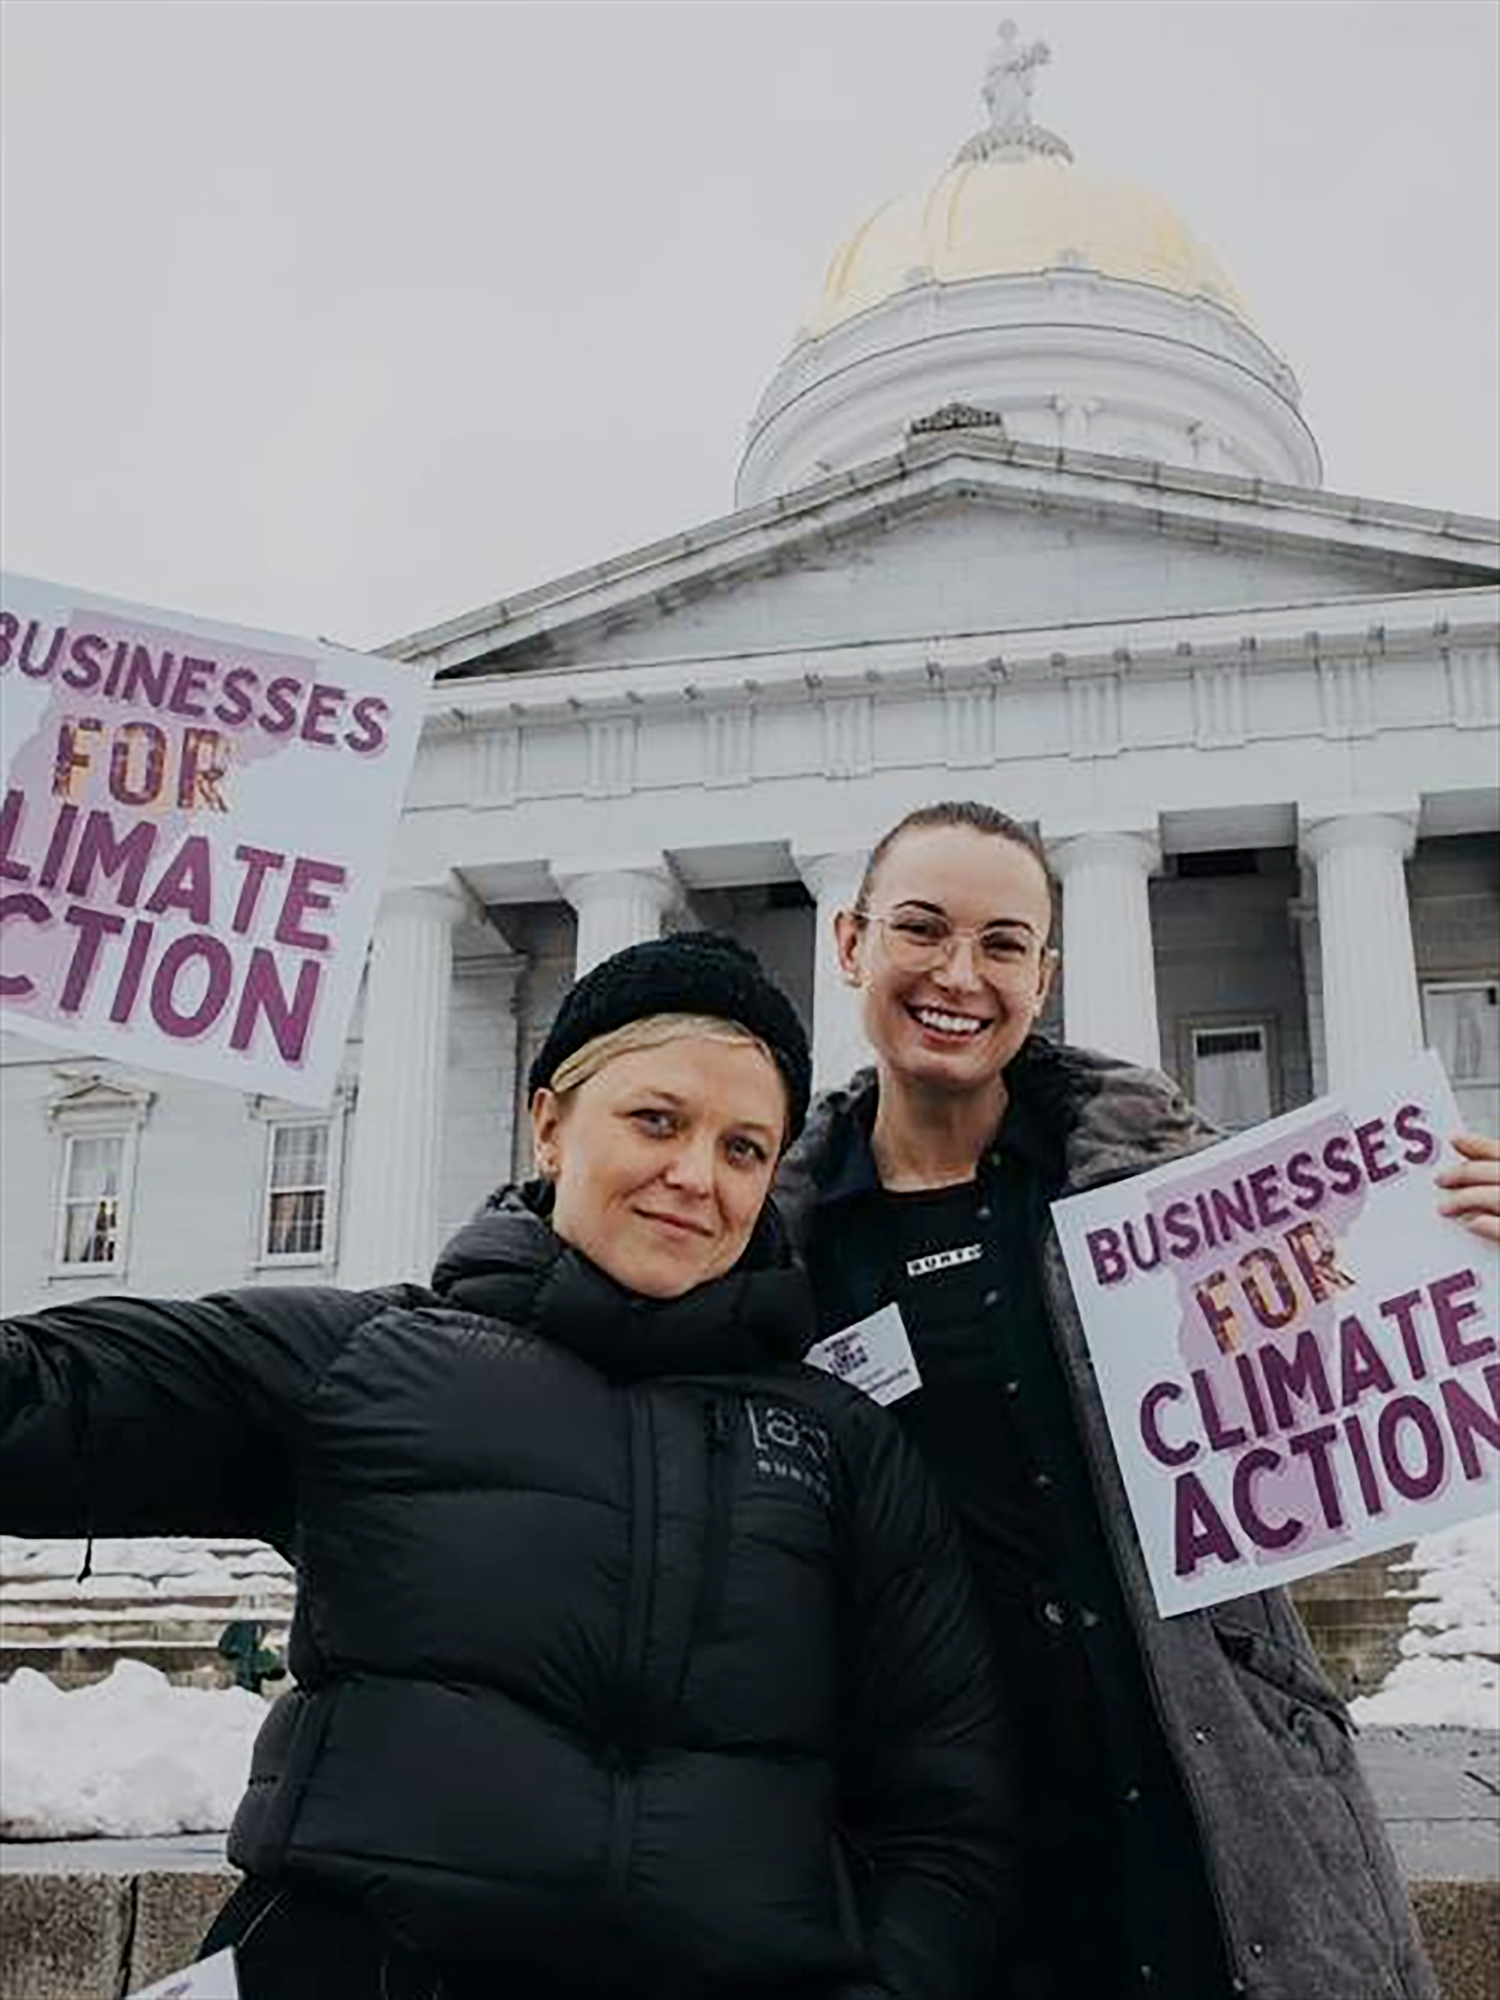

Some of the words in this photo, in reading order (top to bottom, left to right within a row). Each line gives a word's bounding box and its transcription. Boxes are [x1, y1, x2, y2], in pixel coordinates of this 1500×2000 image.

[51, 716, 231, 813] FOR
[1086, 1104, 1435, 1286] BUSINESSES
[1140, 1269, 1497, 1468] CLIMATE
[1194, 1219, 1356, 1357] FOR
[1175, 1362, 1500, 1577] ACTION
